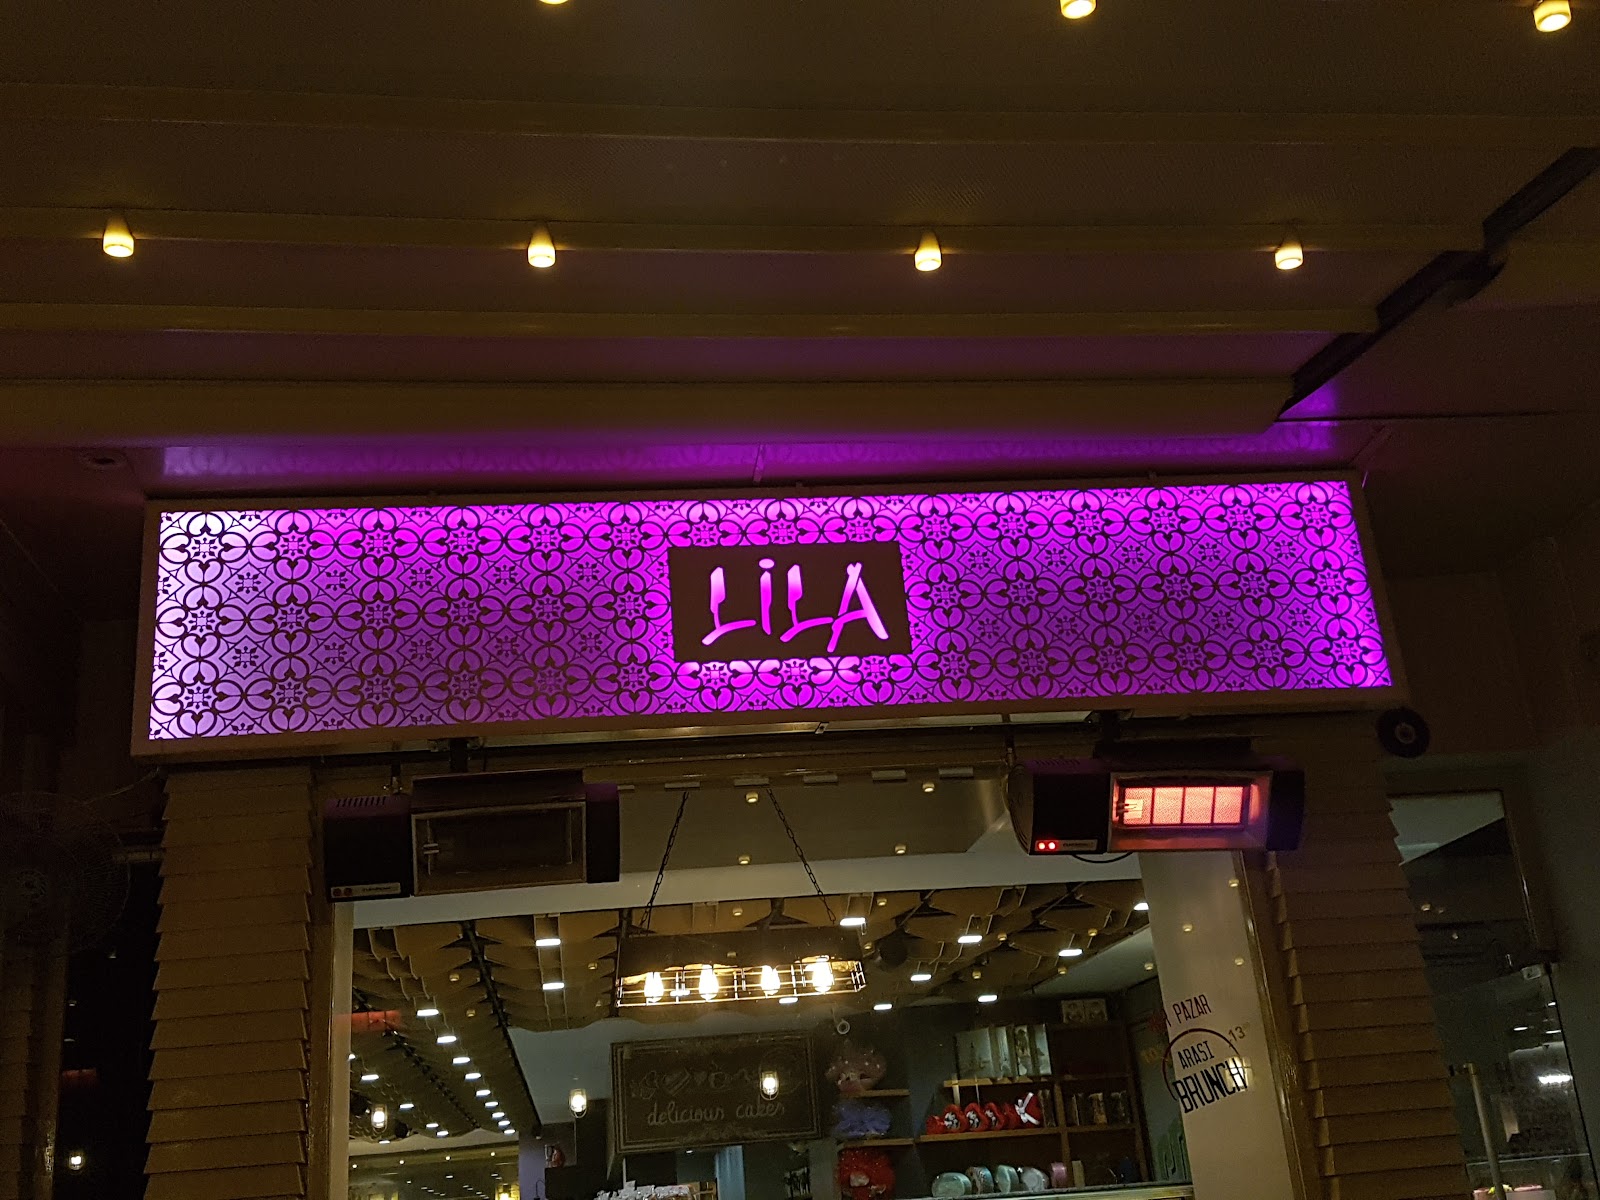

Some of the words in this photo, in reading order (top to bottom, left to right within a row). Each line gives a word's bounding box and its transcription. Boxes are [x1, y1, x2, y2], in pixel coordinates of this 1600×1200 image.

[1172, 994, 1211, 1023] PAZAR
[1178, 1041, 1214, 1069] ARASI
[1173, 1058, 1247, 1113] BRUNCH
[647, 1101, 725, 1125] delicious
[735, 1101, 786, 1119] cakes
